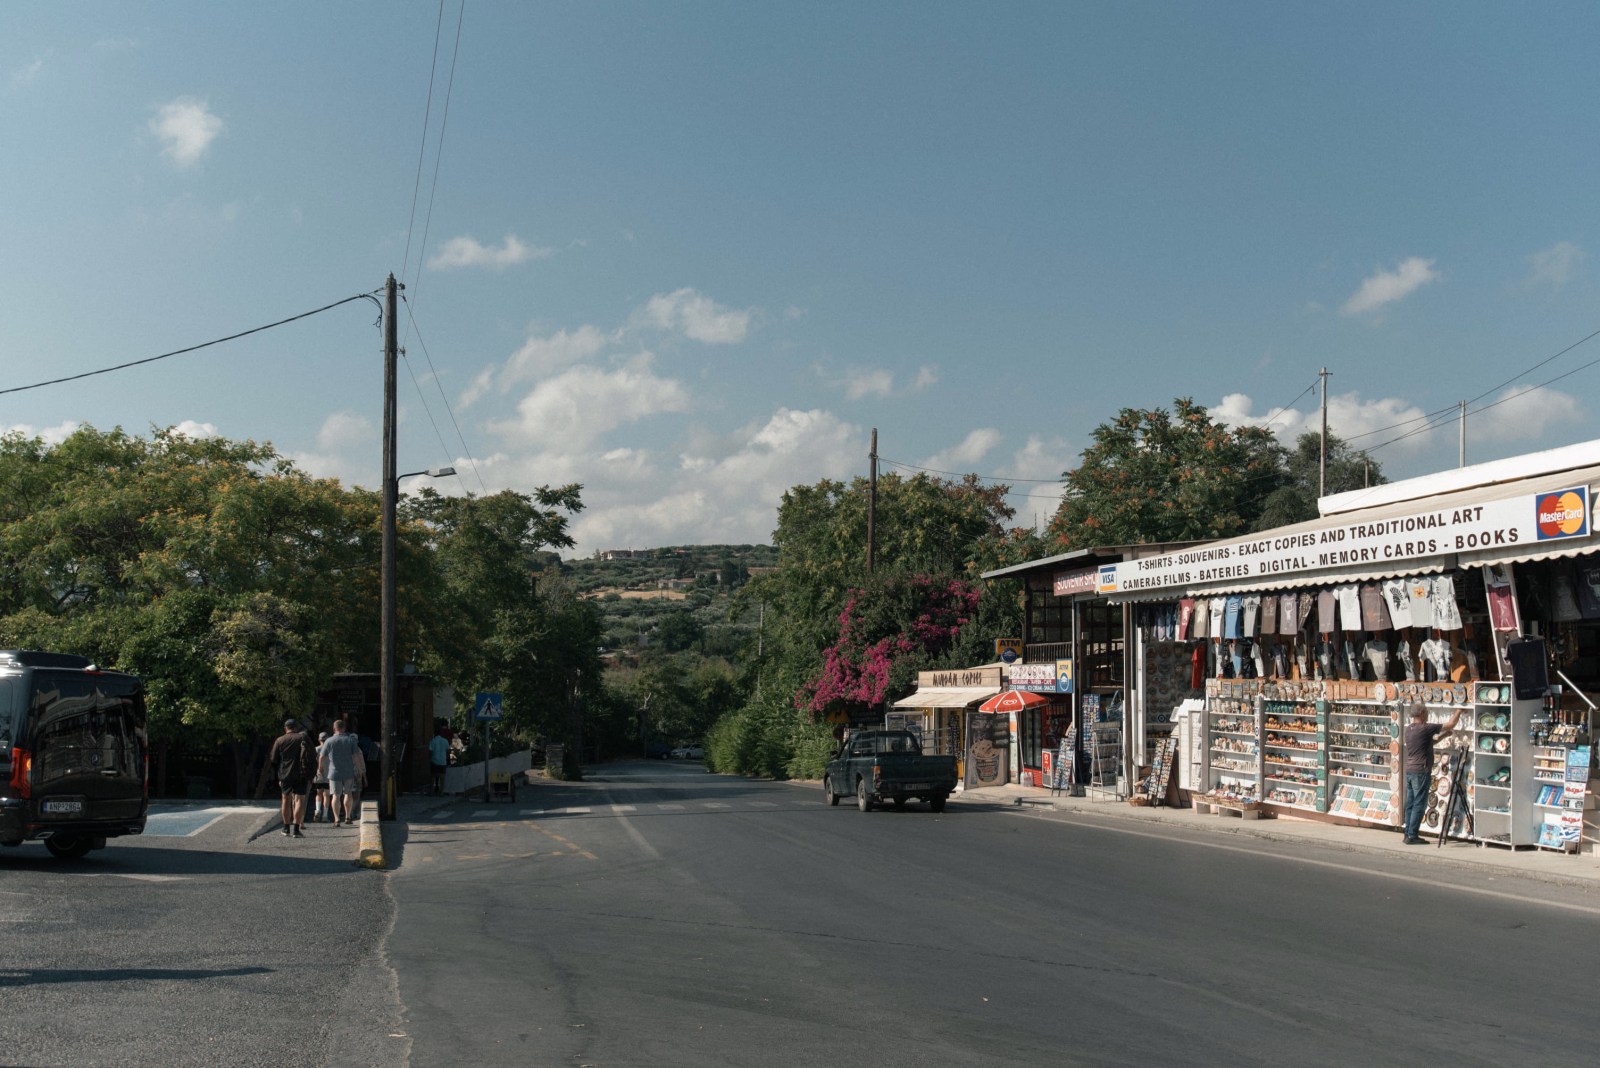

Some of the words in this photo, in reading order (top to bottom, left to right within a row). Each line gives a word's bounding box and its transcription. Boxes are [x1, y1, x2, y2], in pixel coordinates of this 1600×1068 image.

[1539, 507, 1583, 524] MasterCard
[1138, 556, 1172, 571] T-SHIRTS
[1178, 548, 1230, 565] SOUVENIRS
[1239, 541, 1271, 556] EXACT
[1274, 534, 1316, 551] COPIES
[1320, 529, 1345, 544] AND
[1350, 513, 1446, 539] TRADITIONAL
[1452, 506, 1484, 525] ART
[1123, 574, 1162, 590] CAMERAS
[1163, 572, 1191, 585] FILMS
[1199, 564, 1250, 581] BATERIES
[1260, 556, 1308, 573] DIGITAL
[1319, 547, 1378, 566] MEMORY
[1384, 539, 1437, 558] CARDS
[1455, 528, 1519, 549] BOOKS
[1057, 573, 1083, 590] SOUVENIR
[1103, 574, 1114, 584] VISA
[962, 671, 982, 686] COPIES
